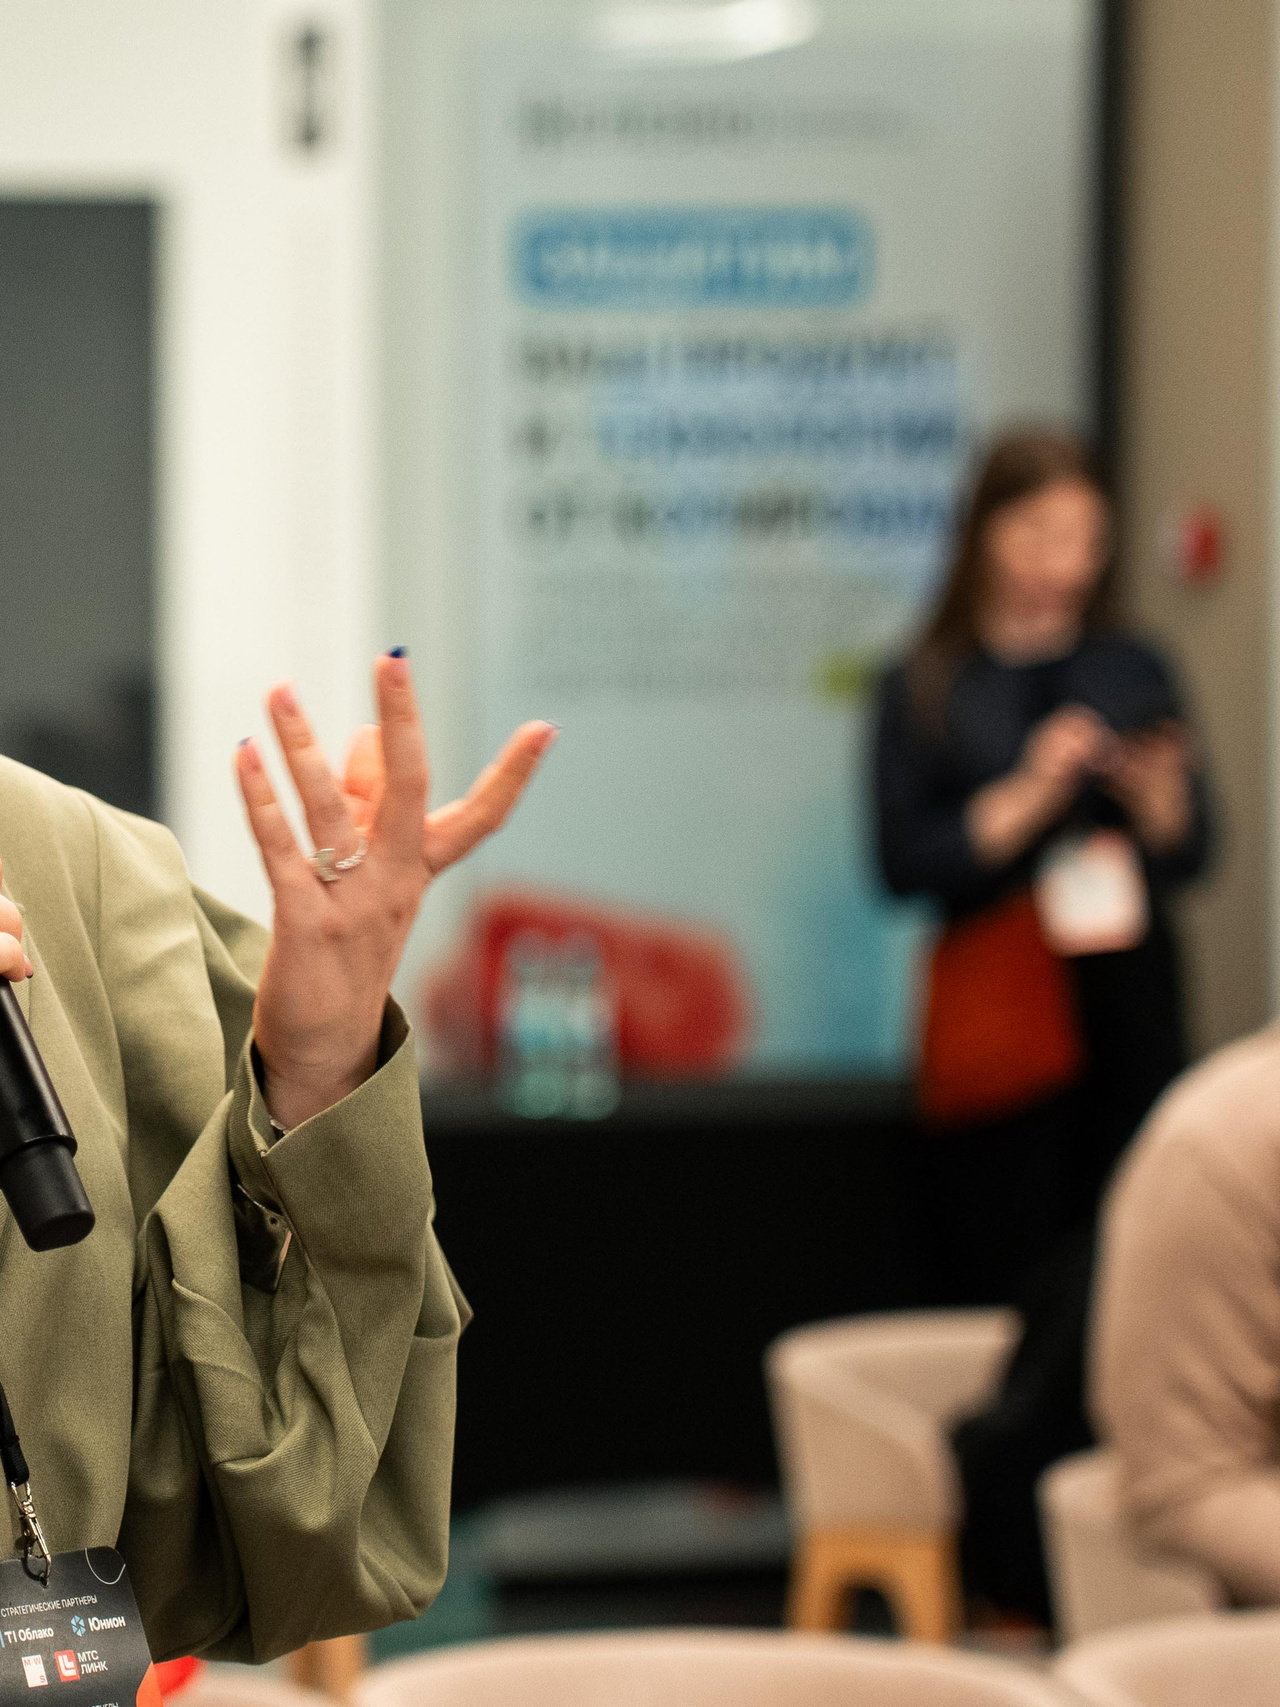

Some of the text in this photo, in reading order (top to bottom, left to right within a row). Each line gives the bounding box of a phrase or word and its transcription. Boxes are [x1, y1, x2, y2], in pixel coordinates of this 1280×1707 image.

[1, 1595, 98, 1617] СТРАТЕГИЧЕСКИЕ ПАРТНЕРЫ
[88, 1616, 126, 1632] Юнион
[18, 1627, 54, 1642] Облако
[77, 1650, 99, 1663] МТС
[80, 1661, 108, 1675] ЛИНК
